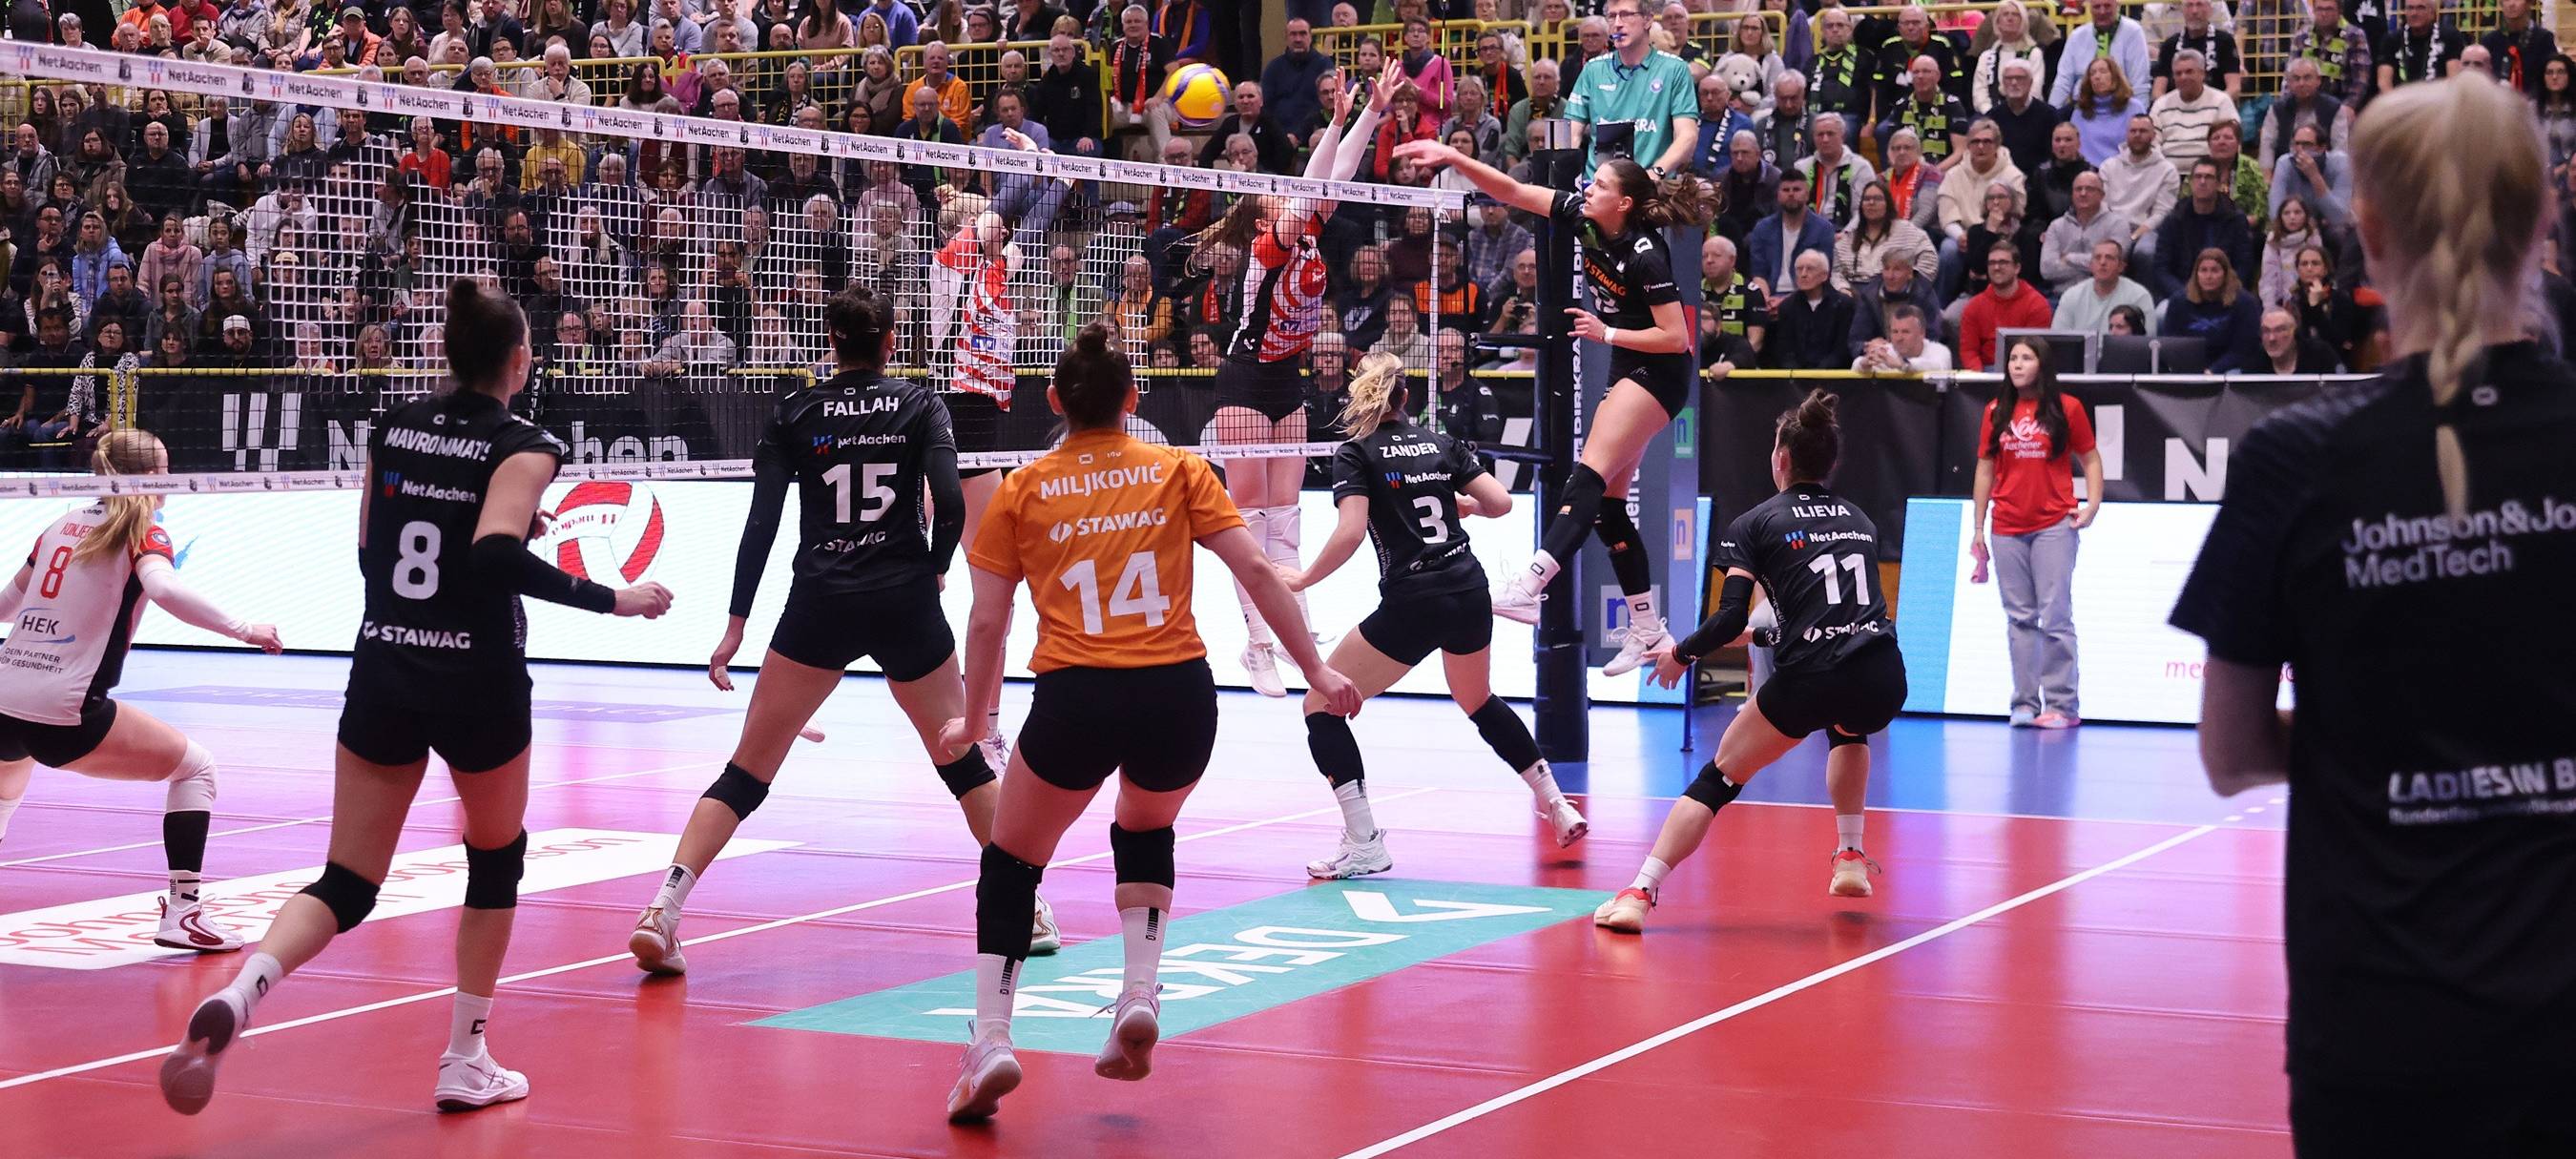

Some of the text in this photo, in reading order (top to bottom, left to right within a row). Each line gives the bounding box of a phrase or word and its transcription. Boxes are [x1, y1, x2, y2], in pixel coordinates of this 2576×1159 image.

[38, 53, 102, 73] NetAachen
[169, 71, 227, 87] NetAachen
[288, 83, 343, 99] NetAachen
[399, 94, 449, 111] NetAachen
[503, 106, 550, 120] NetAachen
[598, 115, 642, 130] NetAachen
[688, 125, 730, 138] NetAachen
[772, 133, 811, 147] NetAachen
[851, 140, 887, 155] NetAachen
[925, 149, 960, 161] NetAachen
[995, 155, 1028, 168] NetAachen
[1061, 160, 1091, 173] NetAachen
[1123, 166, 1153, 178] NetAachen
[1182, 172, 1210, 184] NetAachen
[1589, 264, 1627, 297] STAWAG
[823, 396, 899, 417] FALLAH
[838, 433, 906, 448] NetAachen
[1380, 442, 1440, 459] ZANDER
[402, 480, 476, 503] NetAachen
[821, 463, 898, 524] 15
[1040, 462, 1163, 499] MILJKOVIĆ
[1076, 507, 1167, 536] STAWAG
[1412, 495, 1448, 544] 3
[1792, 505, 1851, 518] ILIEVA
[1809, 530, 1873, 543] NetAachen
[40, 546, 73, 600] 8
[392, 521, 442, 600] 8
[2344, 537, 2513, 589] MedTech
[1059, 550, 1171, 635] 14
[1807, 553, 1870, 606] 11
[21, 615, 60, 635] HEK
[382, 626, 471, 650] STAWAG
[5, 647, 61, 664] DEIN PARTNER
[11, 658, 64, 674] GESUNDHEIT
[2388, 765, 2514, 803] LADIES
